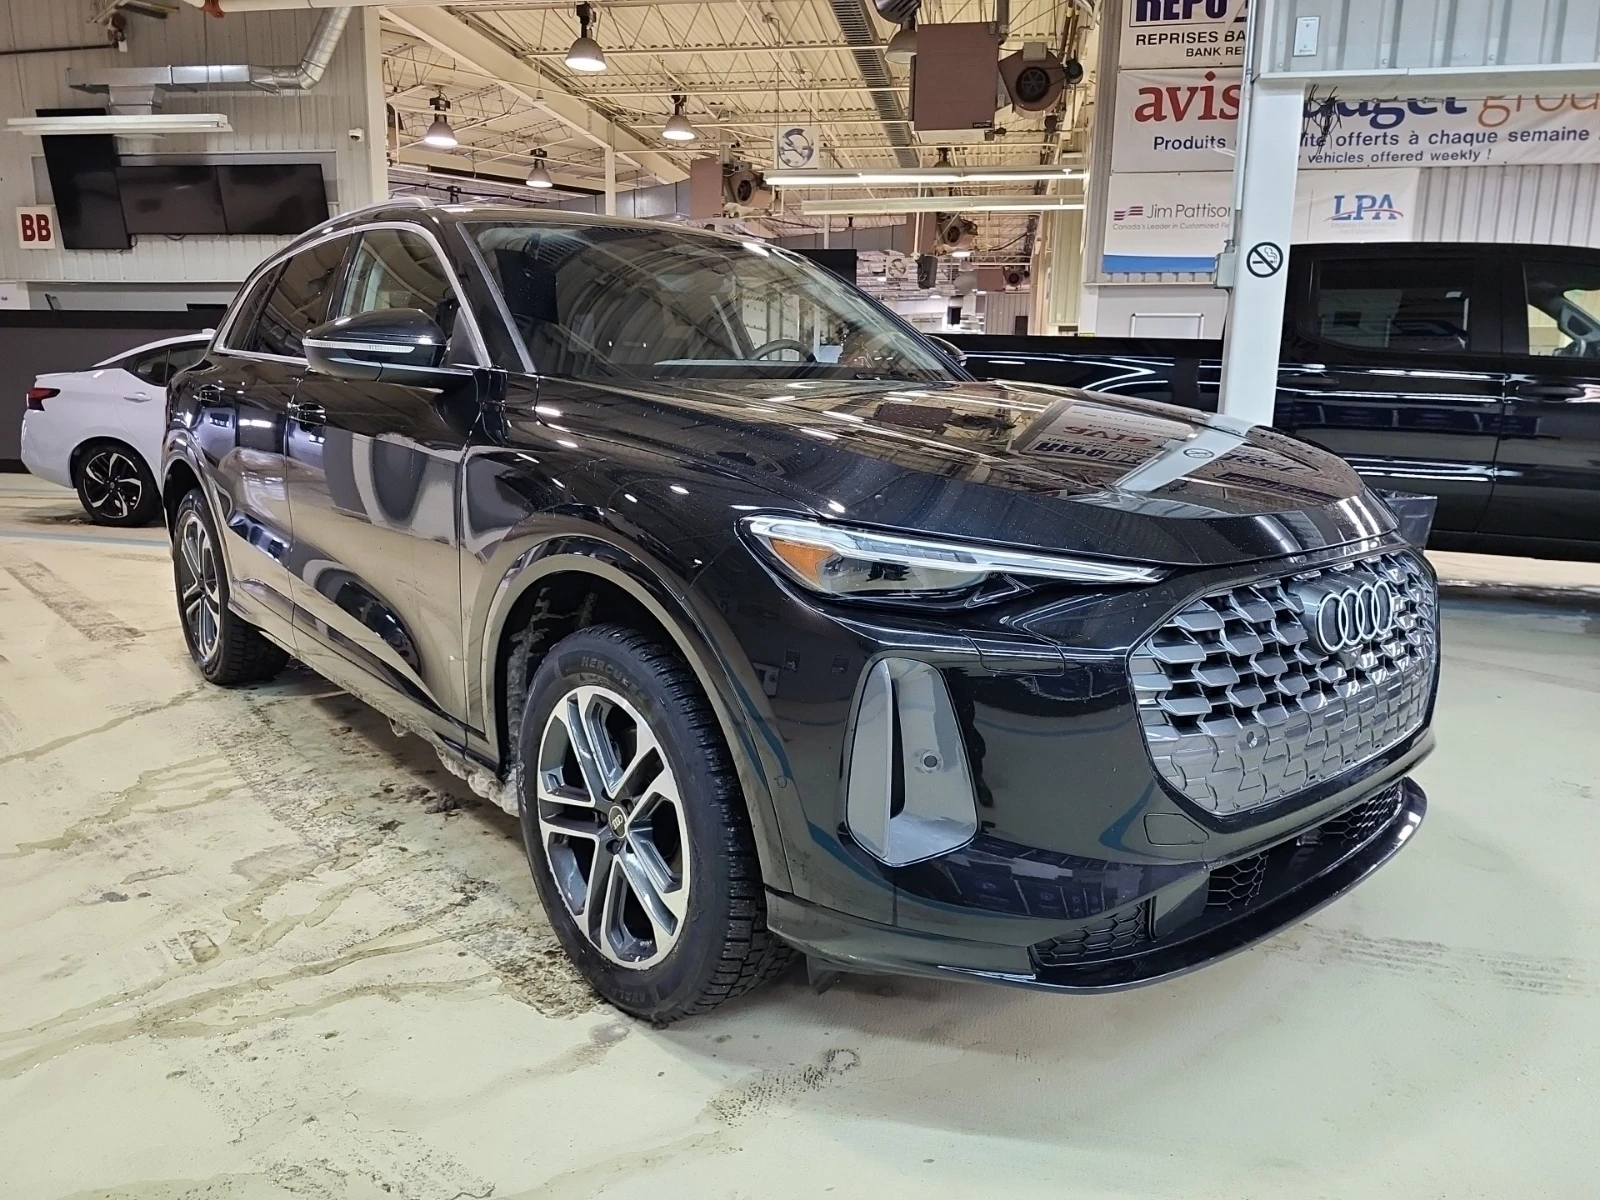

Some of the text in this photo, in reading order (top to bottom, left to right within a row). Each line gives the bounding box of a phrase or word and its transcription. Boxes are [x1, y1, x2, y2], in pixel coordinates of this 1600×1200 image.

[1136, 31, 1218, 46] REPRISES
[1186, 46, 1245, 57] BANK RE
[1135, 71, 1241, 122] avis
[1153, 135, 1226, 150] Produits
[1335, 131, 1400, 147] offerts
[1408, 130, 1420, 145] à
[1428, 129, 1498, 147] chaque
[1507, 126, 1590, 143] semaine
[1308, 152, 1365, 164] vehicles
[1370, 150, 1423, 163] offered
[1430, 149, 1481, 163] weekly
[1146, 204, 1173, 219] Jim
[1331, 194, 1397, 221] LPA
[20, 213, 52, 242] BB
[1112, 223, 1146, 232] Canada's
[1147, 222, 1171, 231] Leader
[1172, 222, 1179, 230] in
[1180, 221, 1220, 230] Customized
